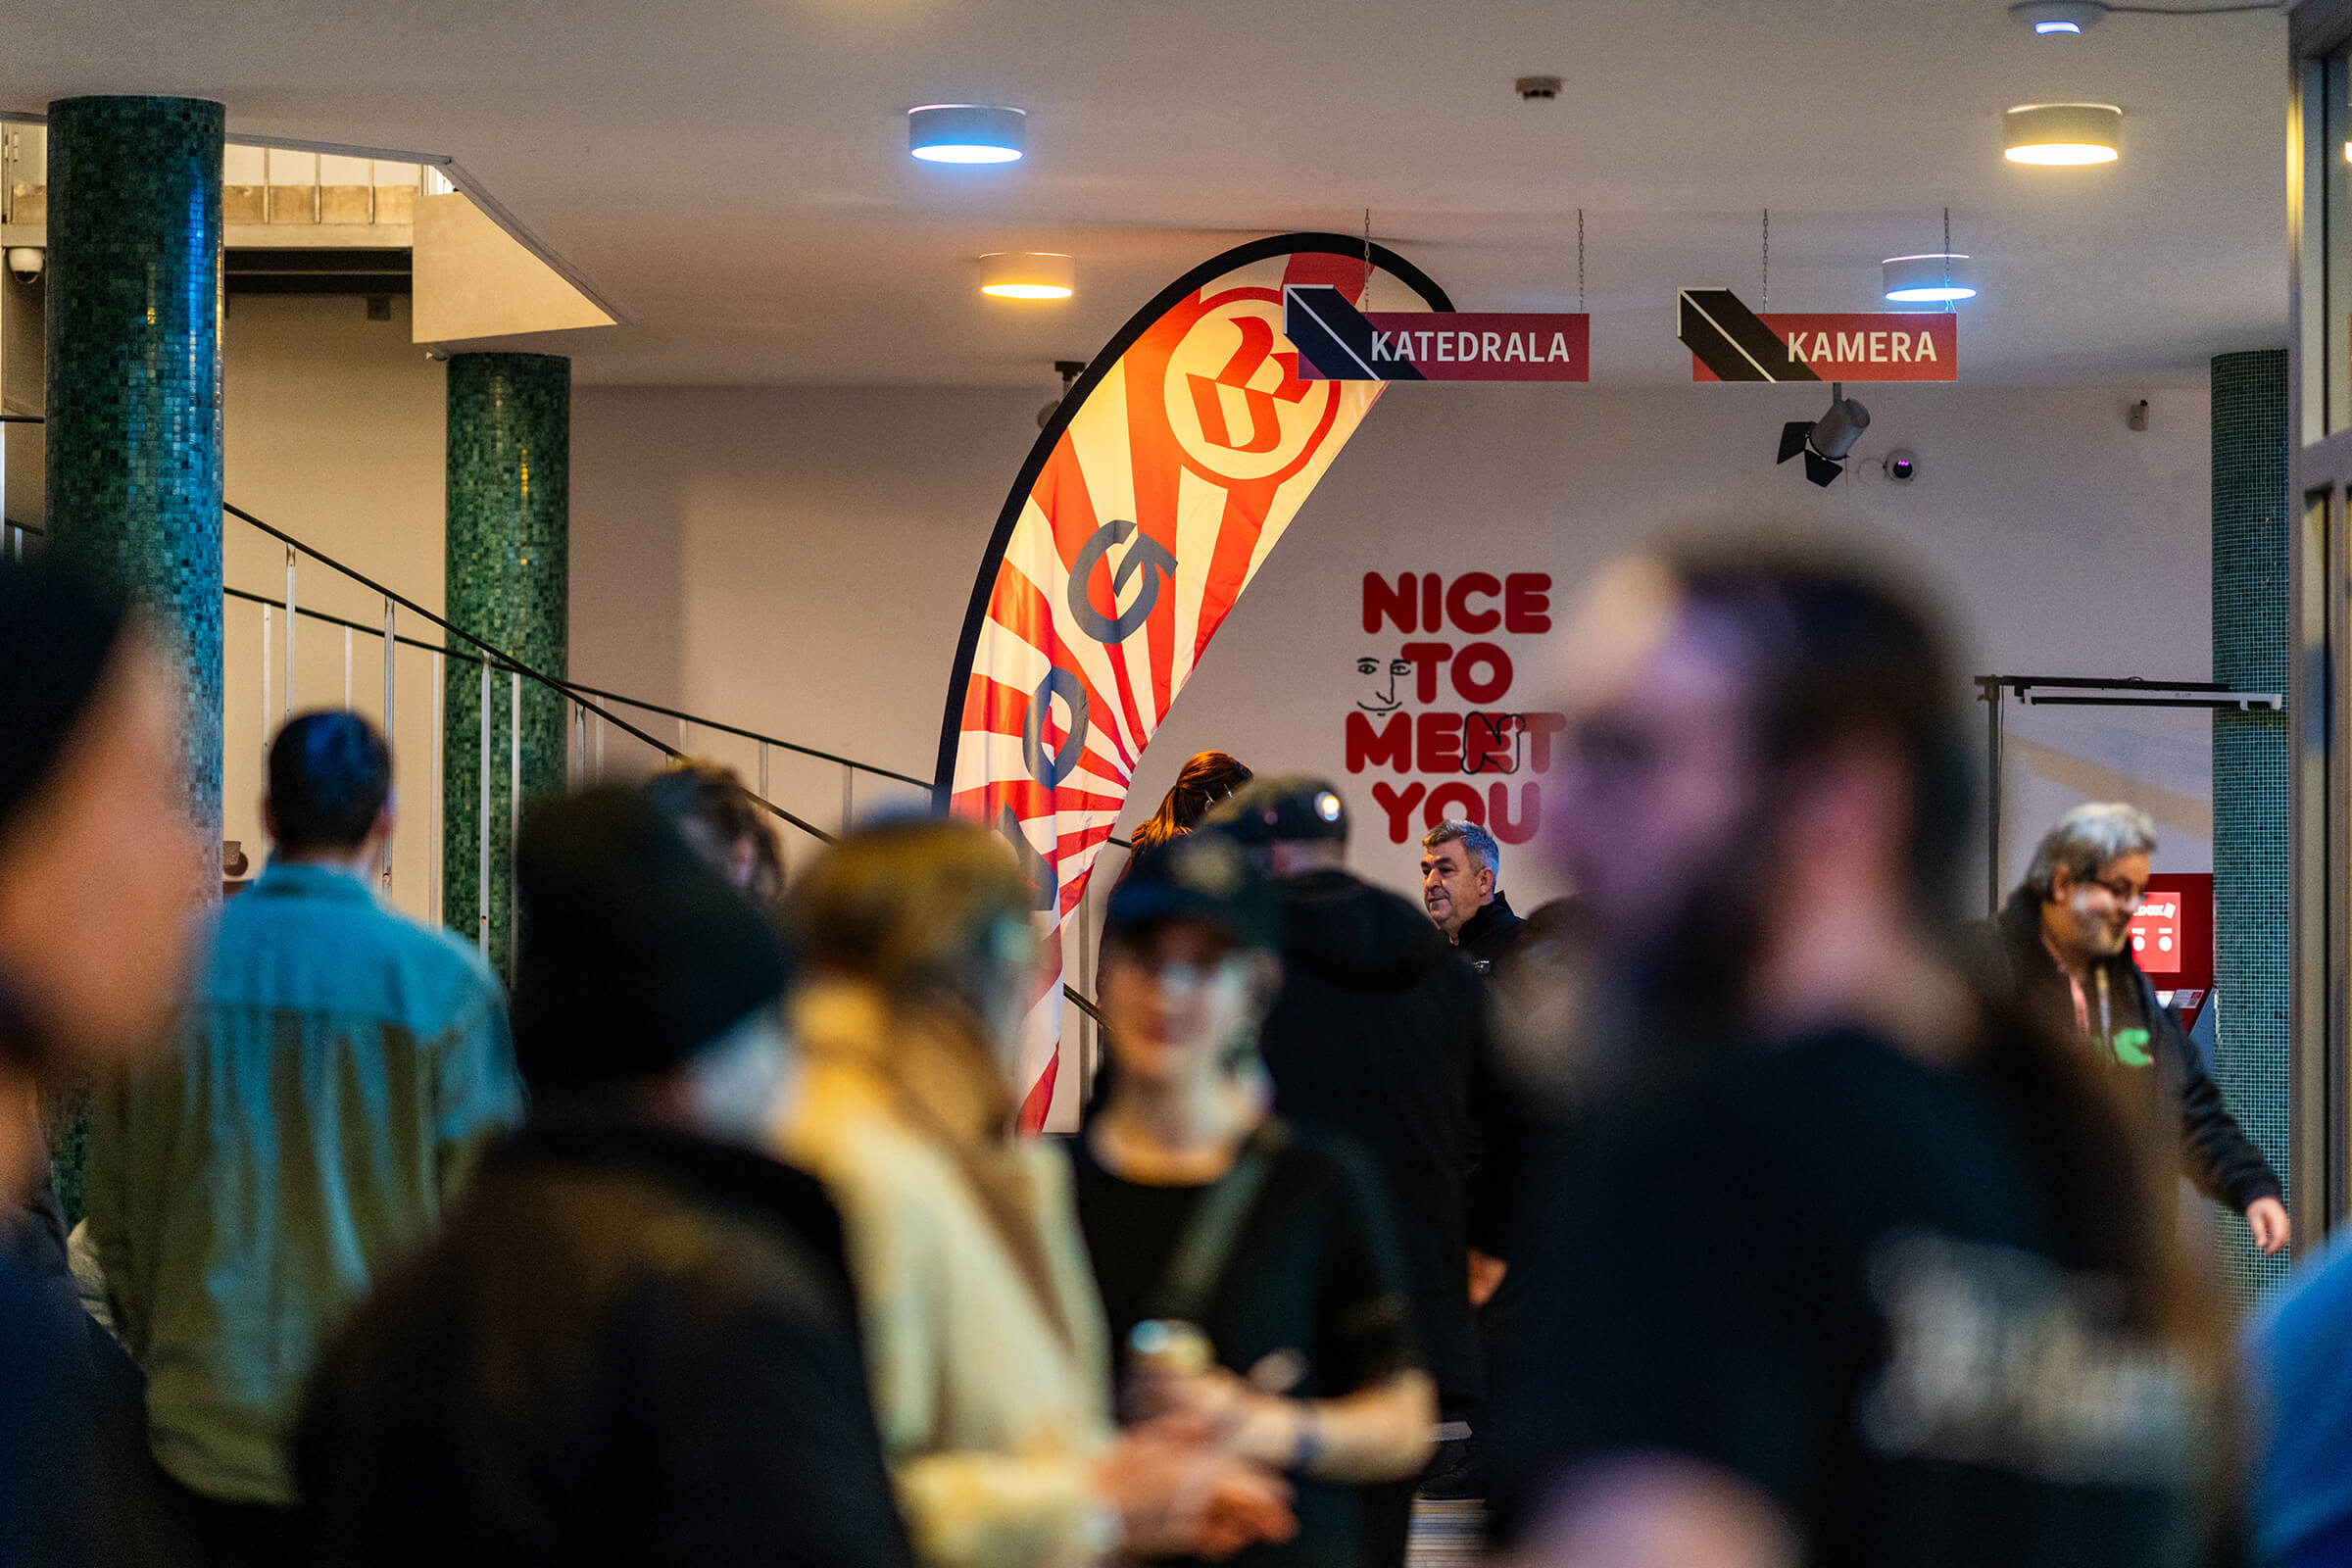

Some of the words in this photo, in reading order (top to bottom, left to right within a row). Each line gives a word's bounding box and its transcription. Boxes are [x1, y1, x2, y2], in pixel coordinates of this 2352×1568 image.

[1371, 331, 1570, 363] KATEDRALA
[1788, 331, 1937, 363] KAMERA
[1362, 571, 1552, 634] NICE
[1400, 642, 1513, 705] TO
[1372, 781, 1541, 845] YOU
